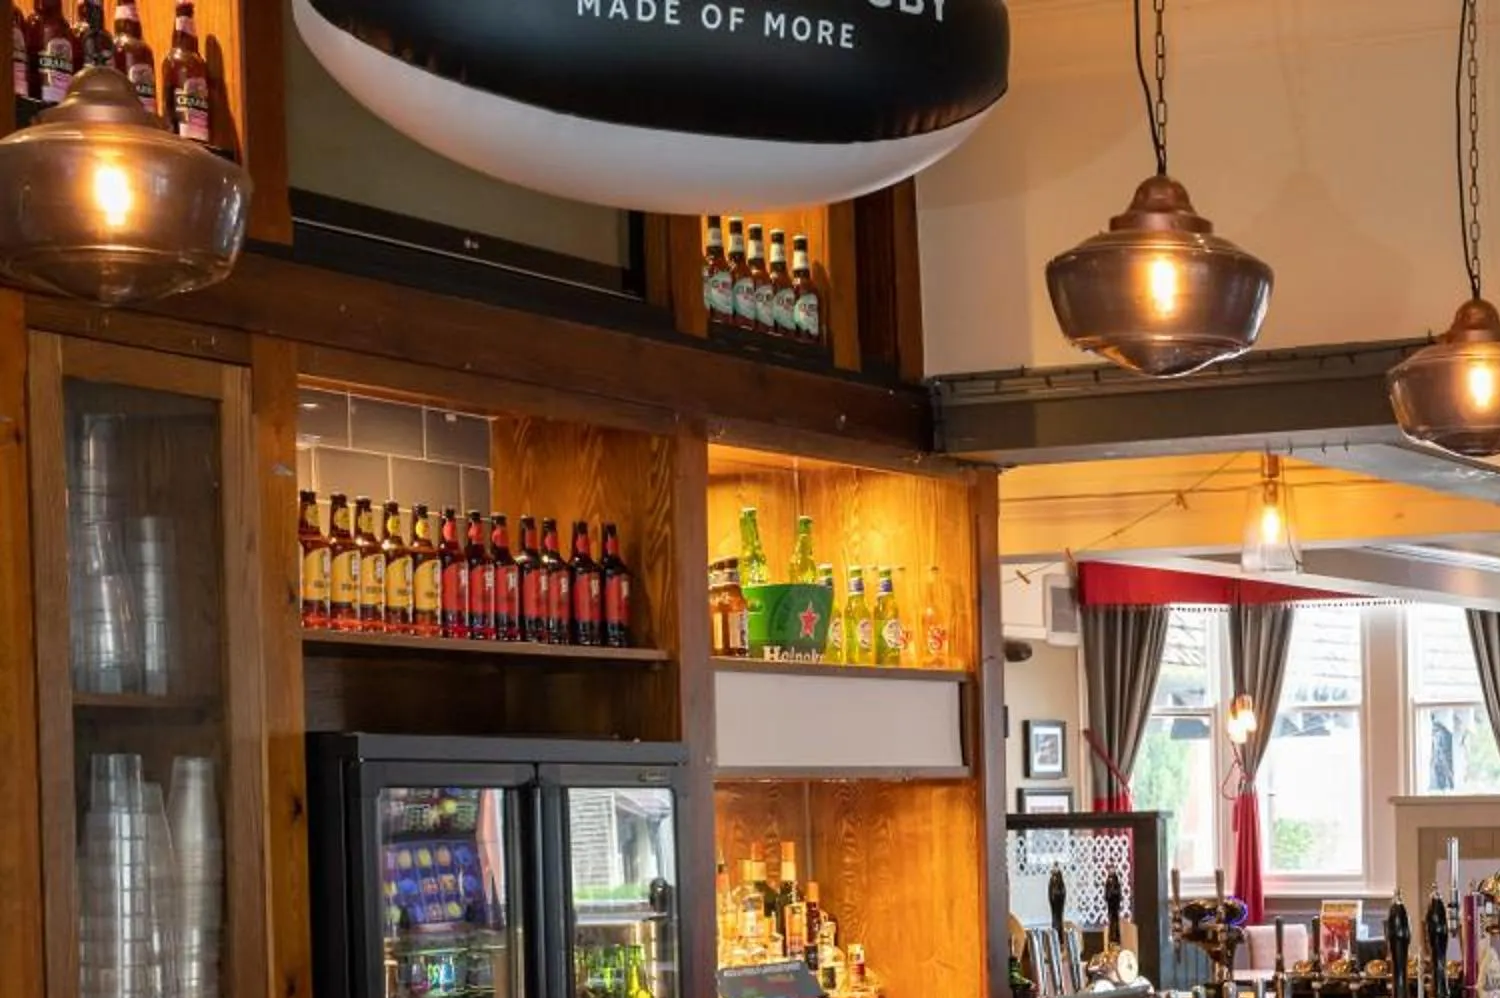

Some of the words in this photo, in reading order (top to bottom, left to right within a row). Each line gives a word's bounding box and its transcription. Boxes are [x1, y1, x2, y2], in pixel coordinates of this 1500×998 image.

[577, 0, 681, 25] MADE
[701, 4, 745, 32] OF
[764, 12, 856, 49] MORE
